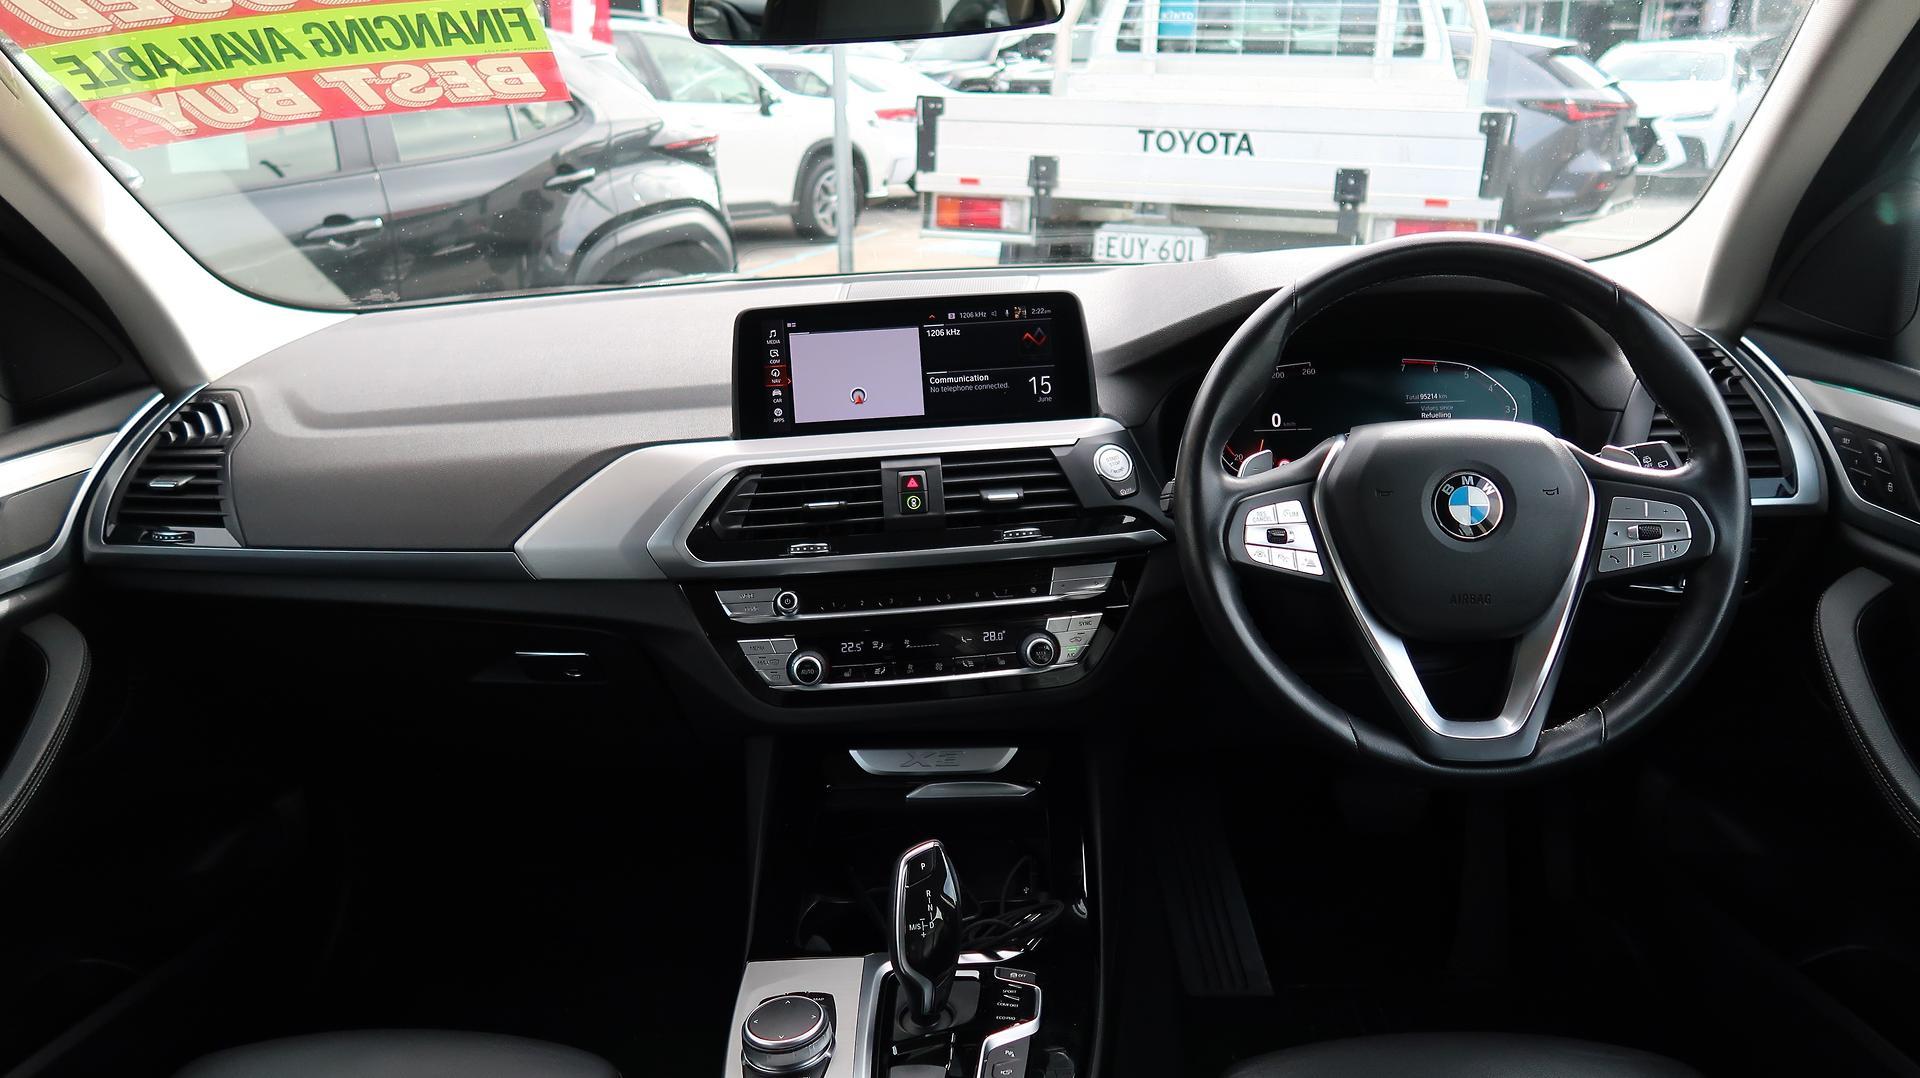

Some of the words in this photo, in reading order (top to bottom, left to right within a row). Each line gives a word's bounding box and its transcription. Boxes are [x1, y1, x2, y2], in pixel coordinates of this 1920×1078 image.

[1138, 128, 1254, 156] TOYOTA
[926, 329, 945, 337] 1206
[945, 328, 961, 336] kHz
[1302, 368, 1316, 376] 260
[1400, 364, 1406, 372] 7
[1432, 365, 1439, 373] 6
[929, 374, 990, 385] Communication
[1464, 371, 1470, 379] 5
[940, 384, 974, 393] telephone
[974, 382, 1010, 391] connected.
[1028, 375, 1052, 395] 15
[1271, 413, 1281, 428] 0
[1441, 475, 1495, 496] BMW
[1449, 592, 1492, 605] AIRBAG
[900, 751, 961, 768] X3
